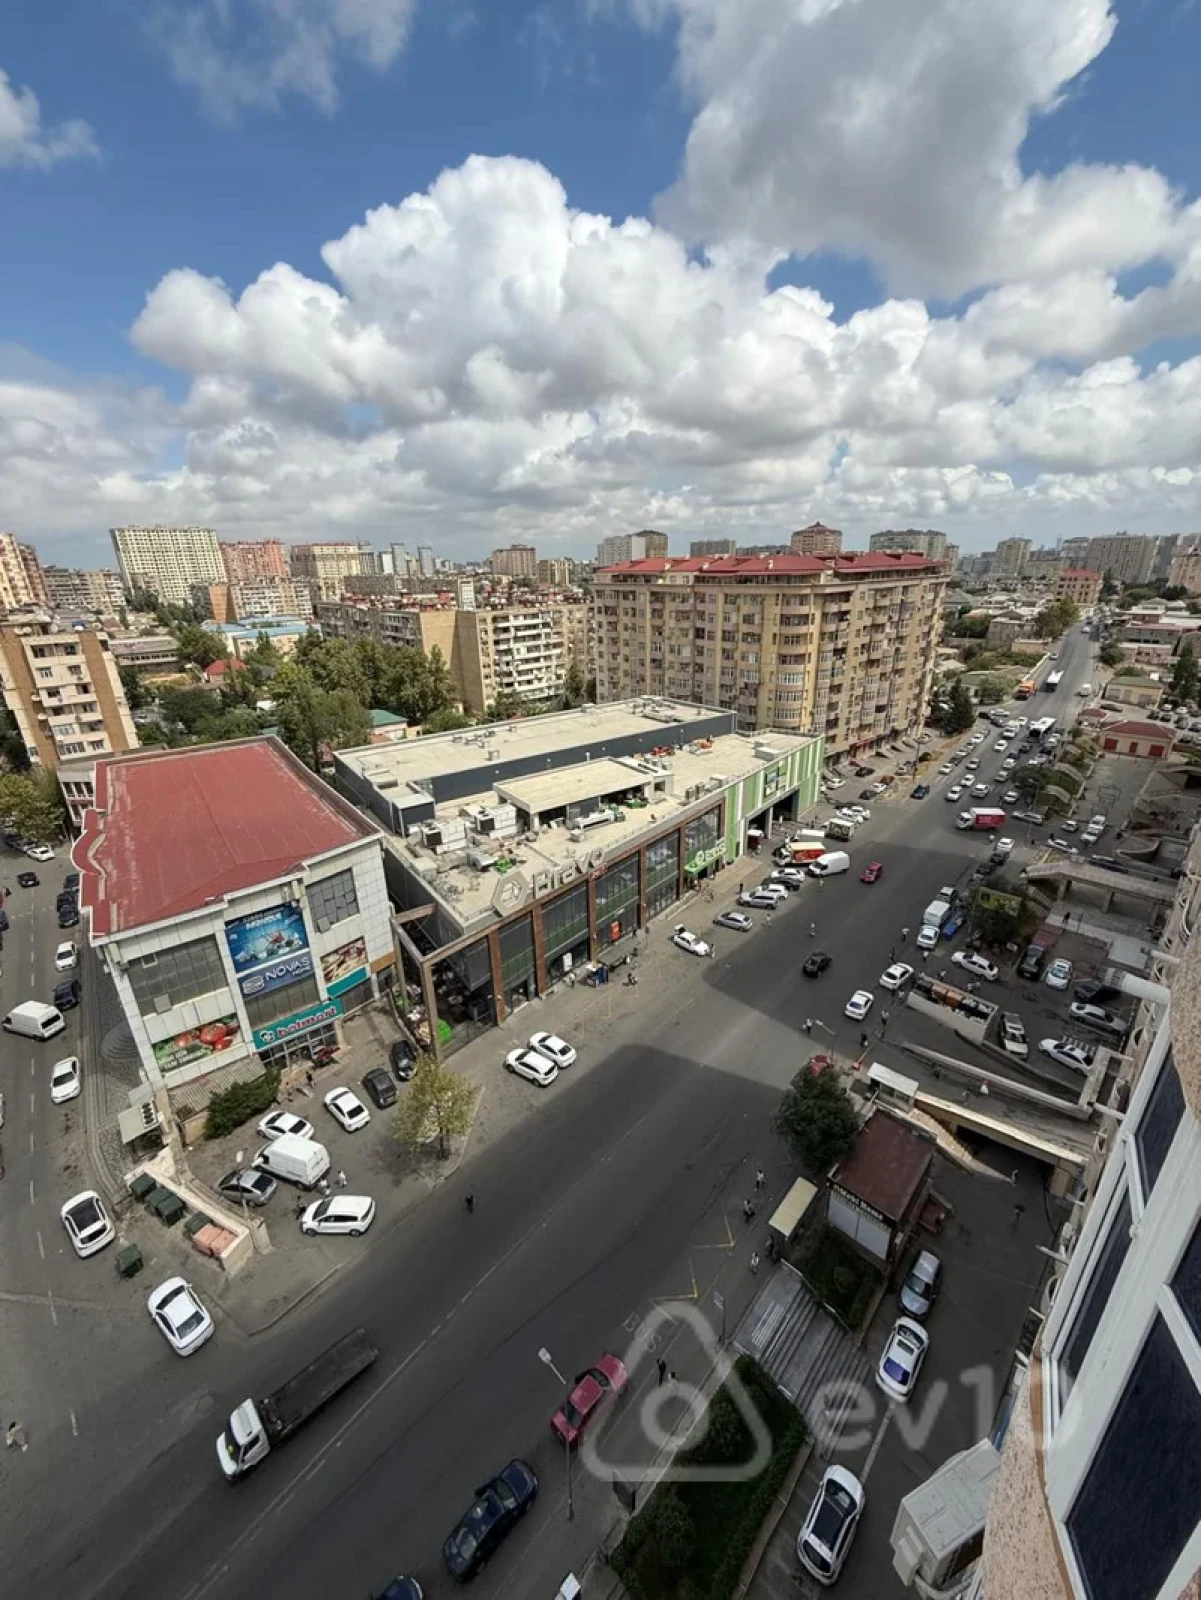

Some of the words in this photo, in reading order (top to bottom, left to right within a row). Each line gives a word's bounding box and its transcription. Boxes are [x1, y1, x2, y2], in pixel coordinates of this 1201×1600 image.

[533, 847, 605, 899] Bravo
[265, 956, 310, 981] NOVAS
[622, 1312, 662, 1353] BUS
